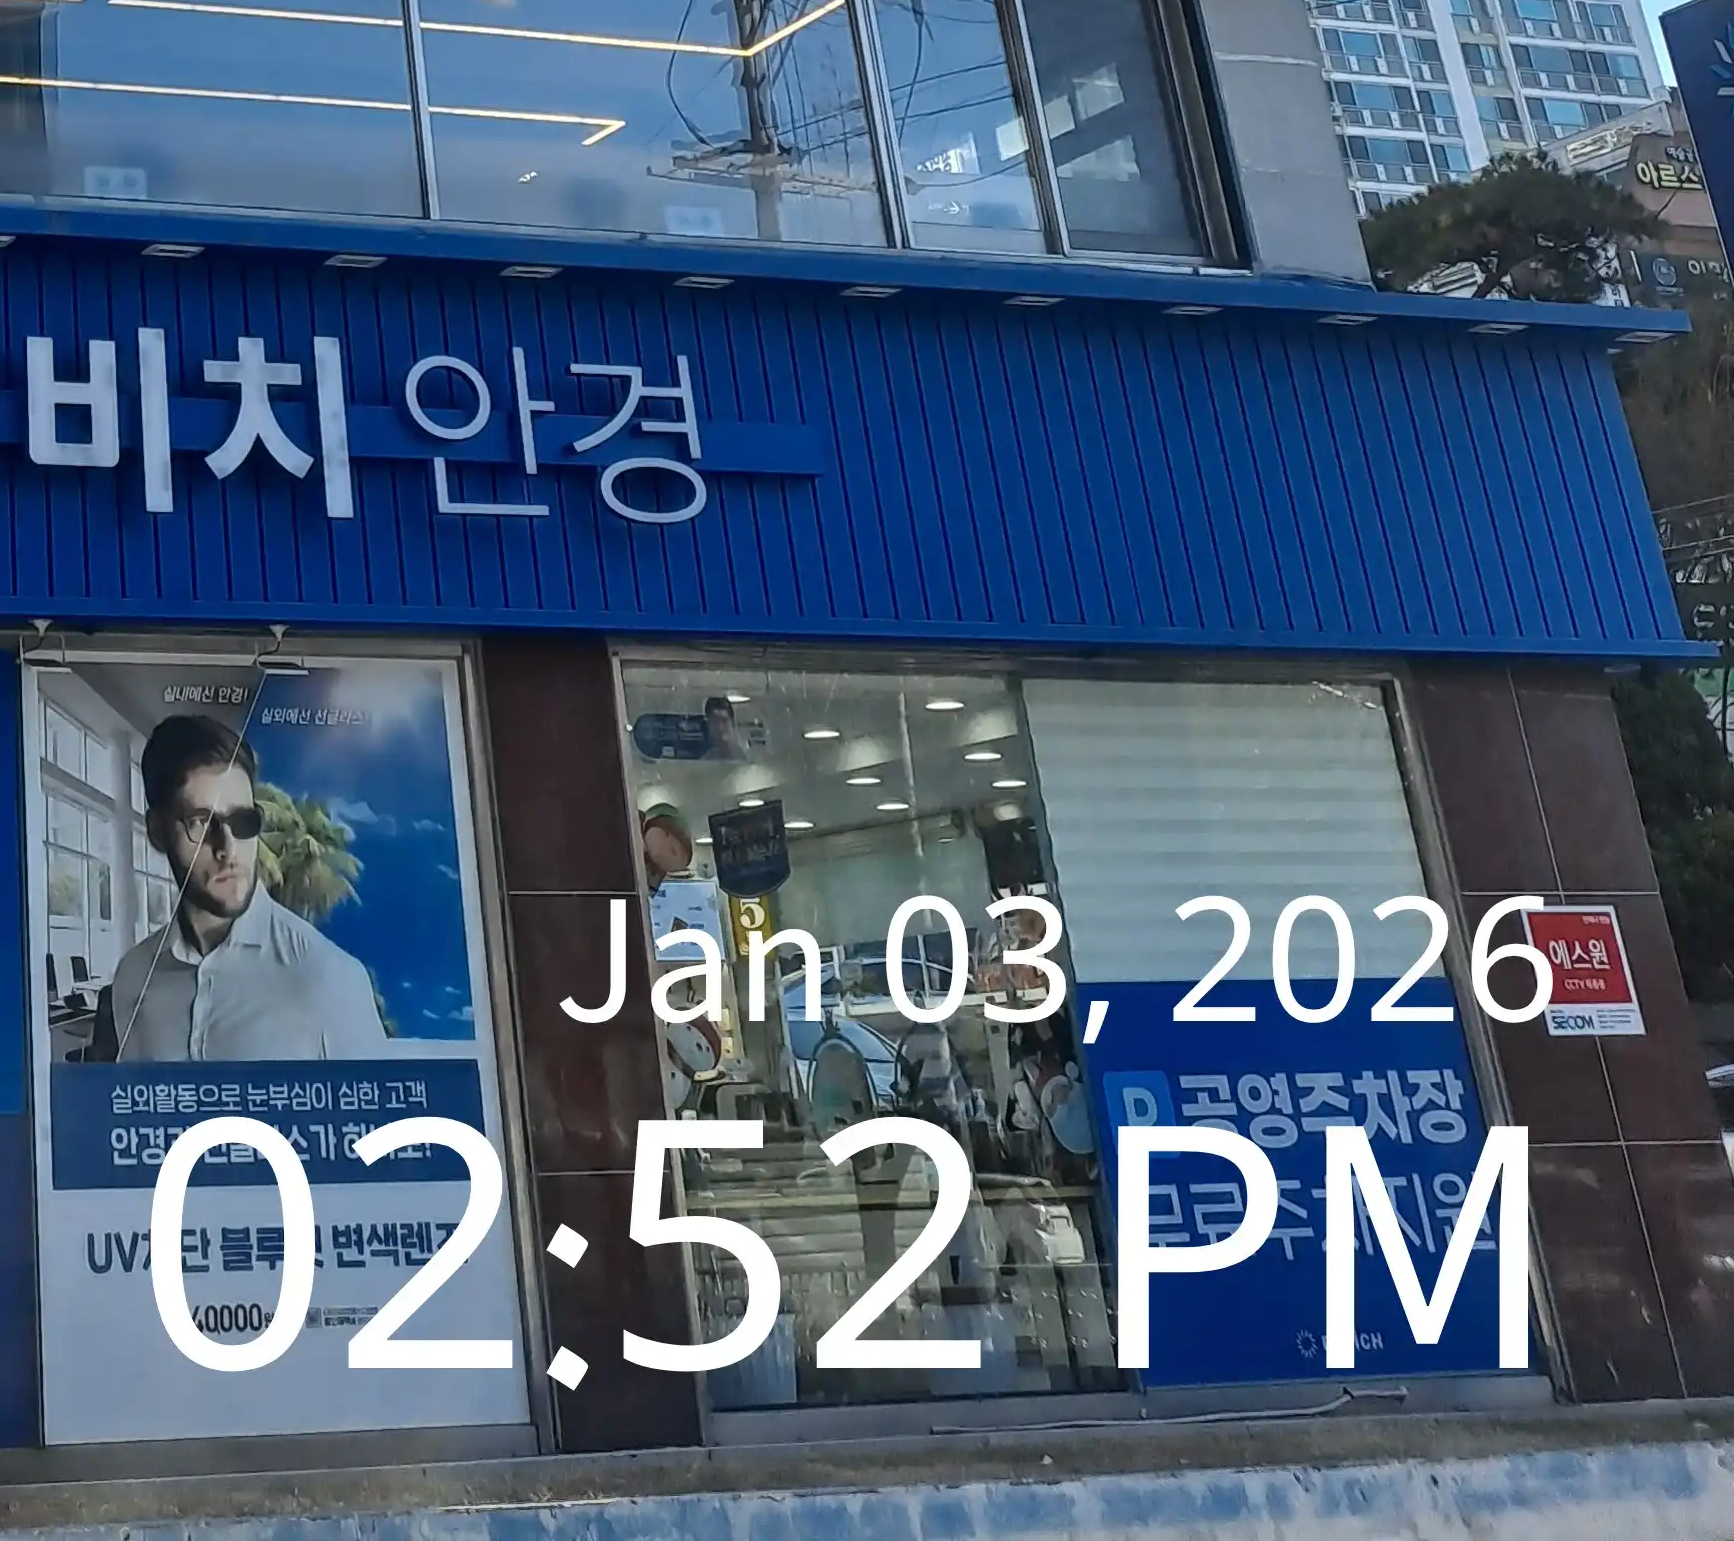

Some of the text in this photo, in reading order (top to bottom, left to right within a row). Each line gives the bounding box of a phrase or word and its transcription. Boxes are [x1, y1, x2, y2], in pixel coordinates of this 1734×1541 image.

[1549, 938, 1611, 970] 에스원
[1551, 1015, 1595, 1030] SECOM
[110, 1079, 428, 1115] 실외활동으로 눈부심이 심한 고객
[1178, 1068, 1469, 1150] 공영주차장
